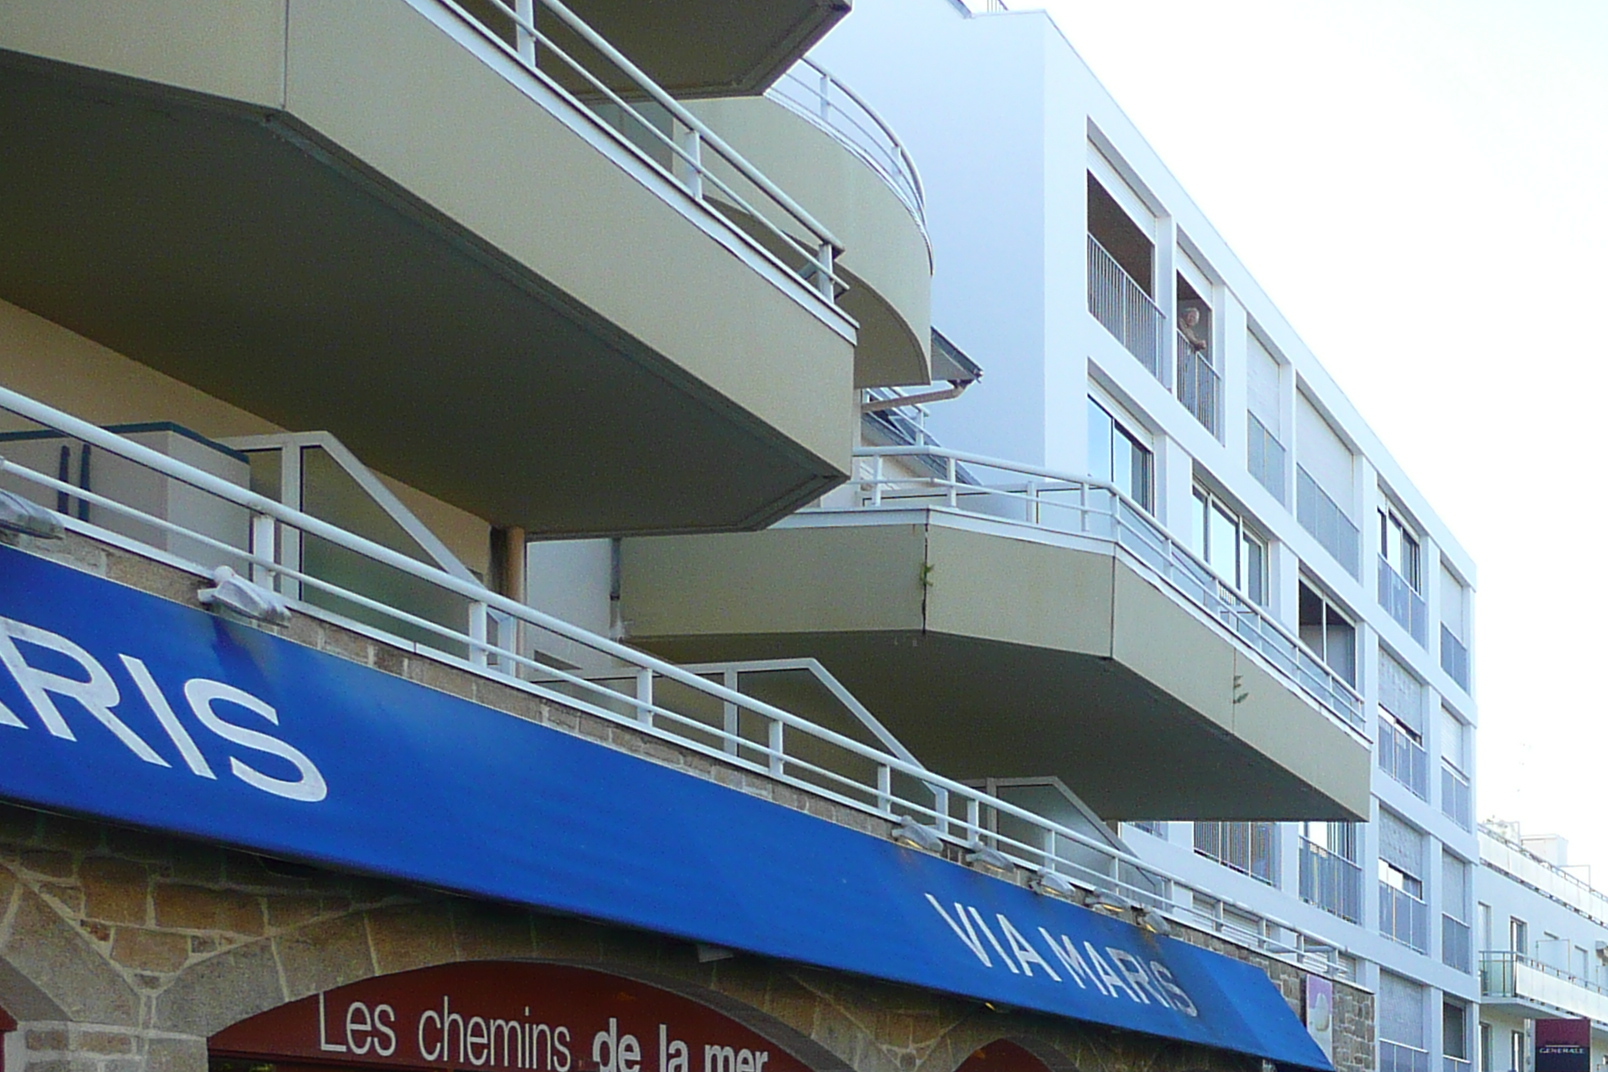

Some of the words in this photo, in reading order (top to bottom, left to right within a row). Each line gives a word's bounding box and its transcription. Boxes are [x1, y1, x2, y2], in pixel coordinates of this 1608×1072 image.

[0, 615, 328, 803] RIS
[925, 892, 1062, 983] VIA
[1038, 926, 1198, 1018] MARIS
[319, 991, 397, 1057] Les
